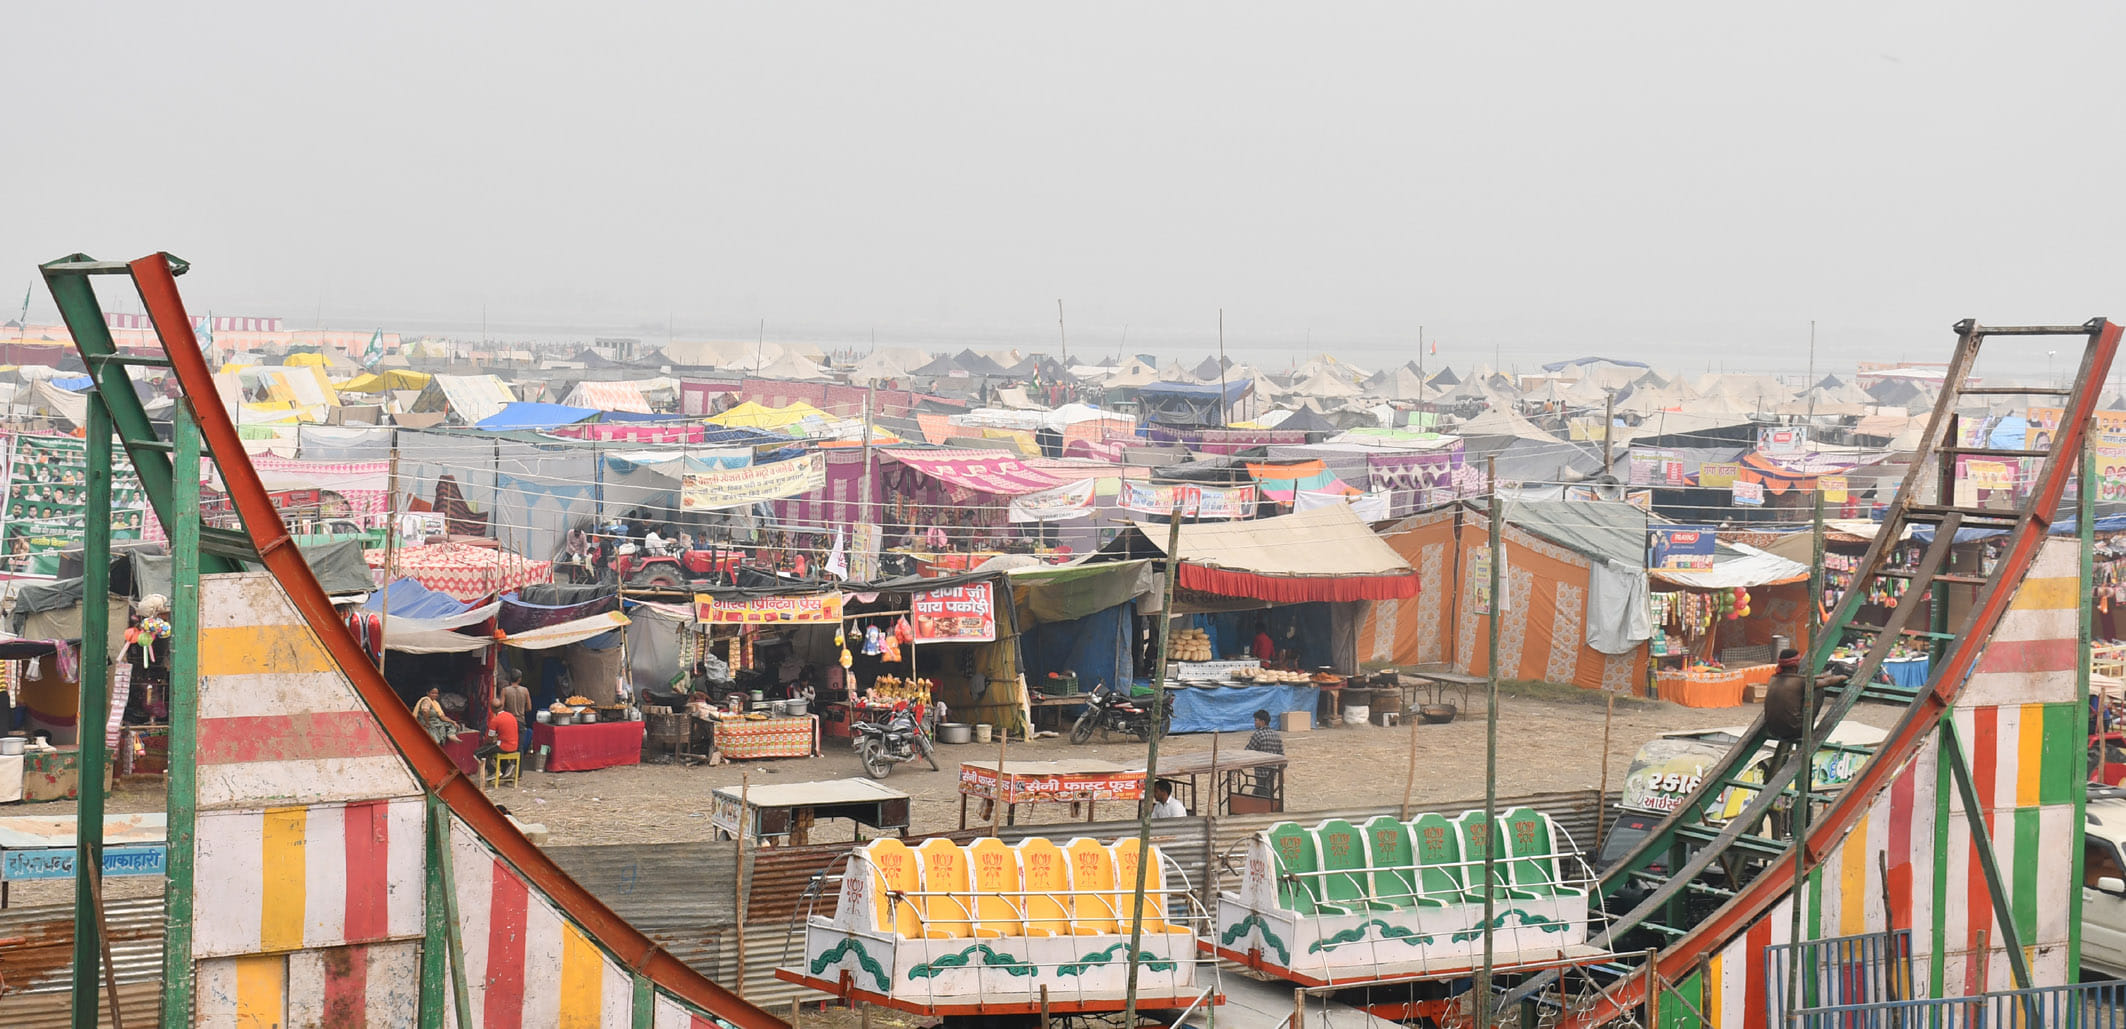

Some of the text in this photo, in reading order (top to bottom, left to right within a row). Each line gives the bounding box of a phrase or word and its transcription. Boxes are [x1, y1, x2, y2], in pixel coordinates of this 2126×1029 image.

[965, 585, 986, 599] जी
[917, 601, 943, 612] चाय
[1064, 781, 1106, 791] फास्ट
[1109, 780, 1137, 792] फूड
